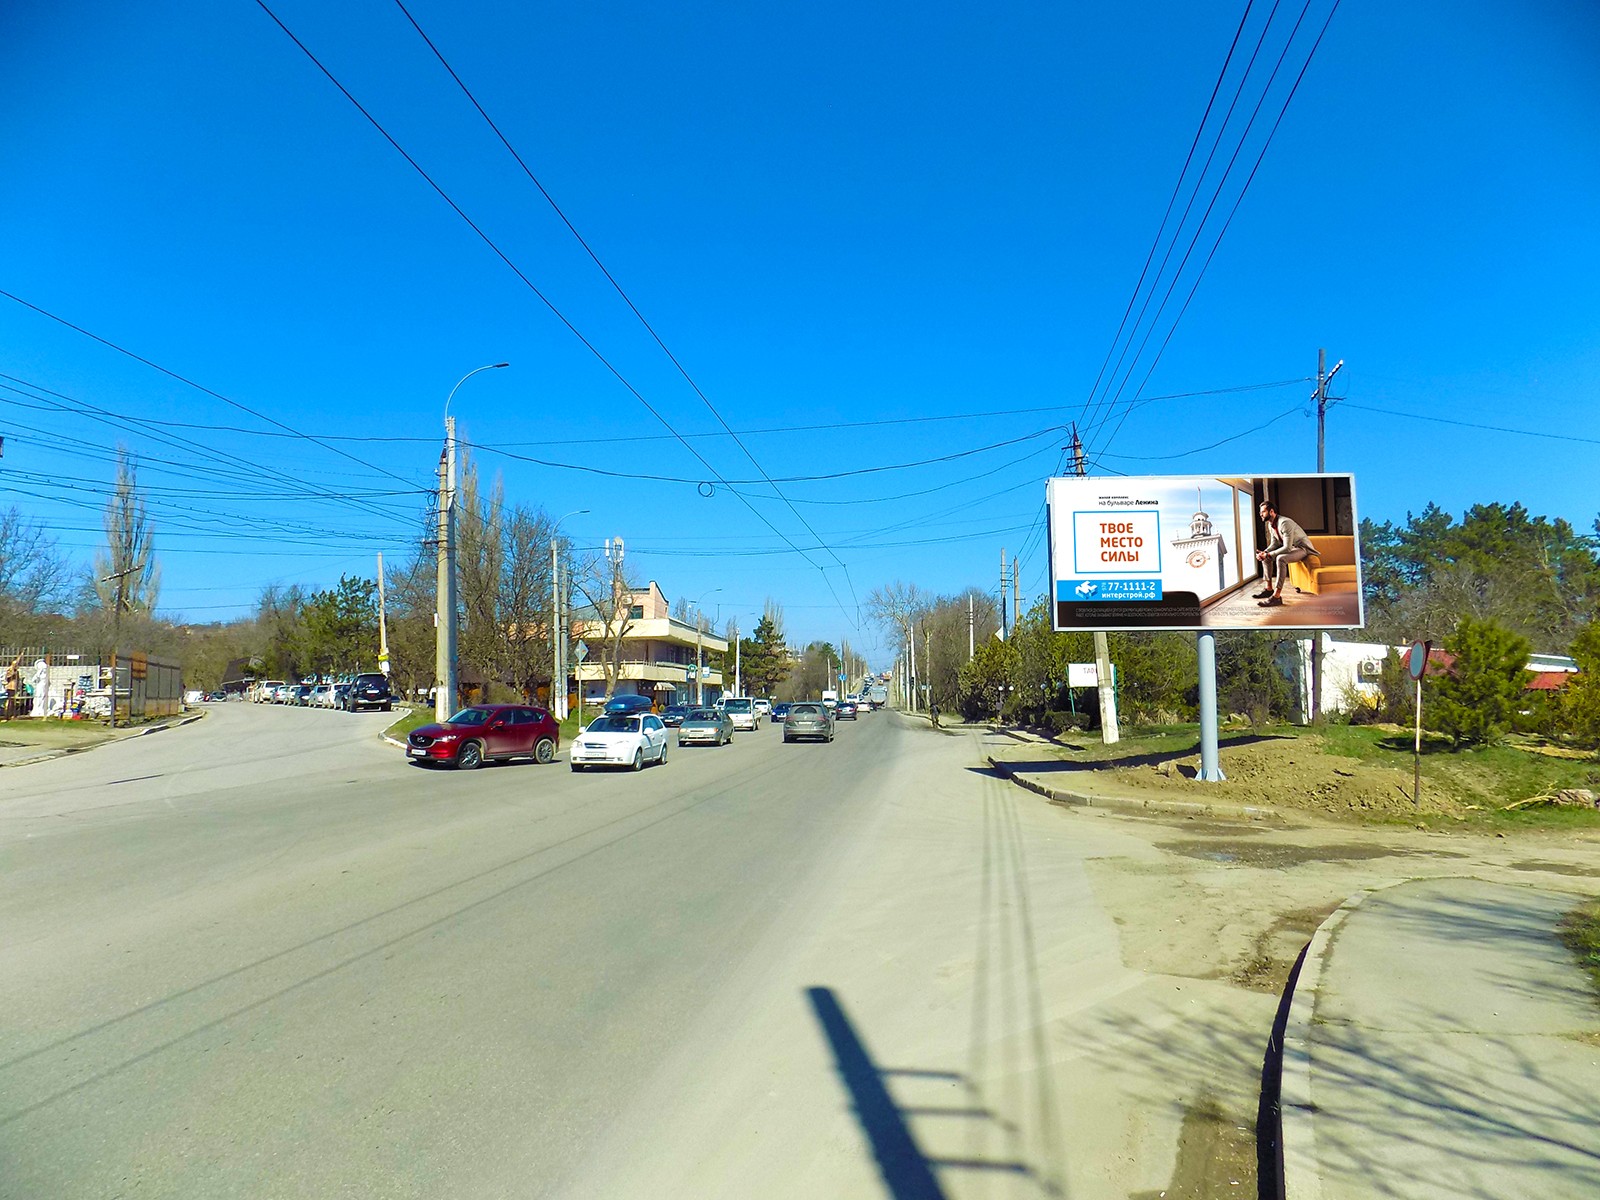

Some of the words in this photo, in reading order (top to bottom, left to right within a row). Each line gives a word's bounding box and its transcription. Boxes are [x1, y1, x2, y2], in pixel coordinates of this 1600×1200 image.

[1099, 523, 1133, 534] ТВОЕ
[1100, 537, 1143, 548] МЕСТО
[1101, 551, 1139, 562] СИЛЫ
[1108, 581, 1155, 591] 77-1111-2
